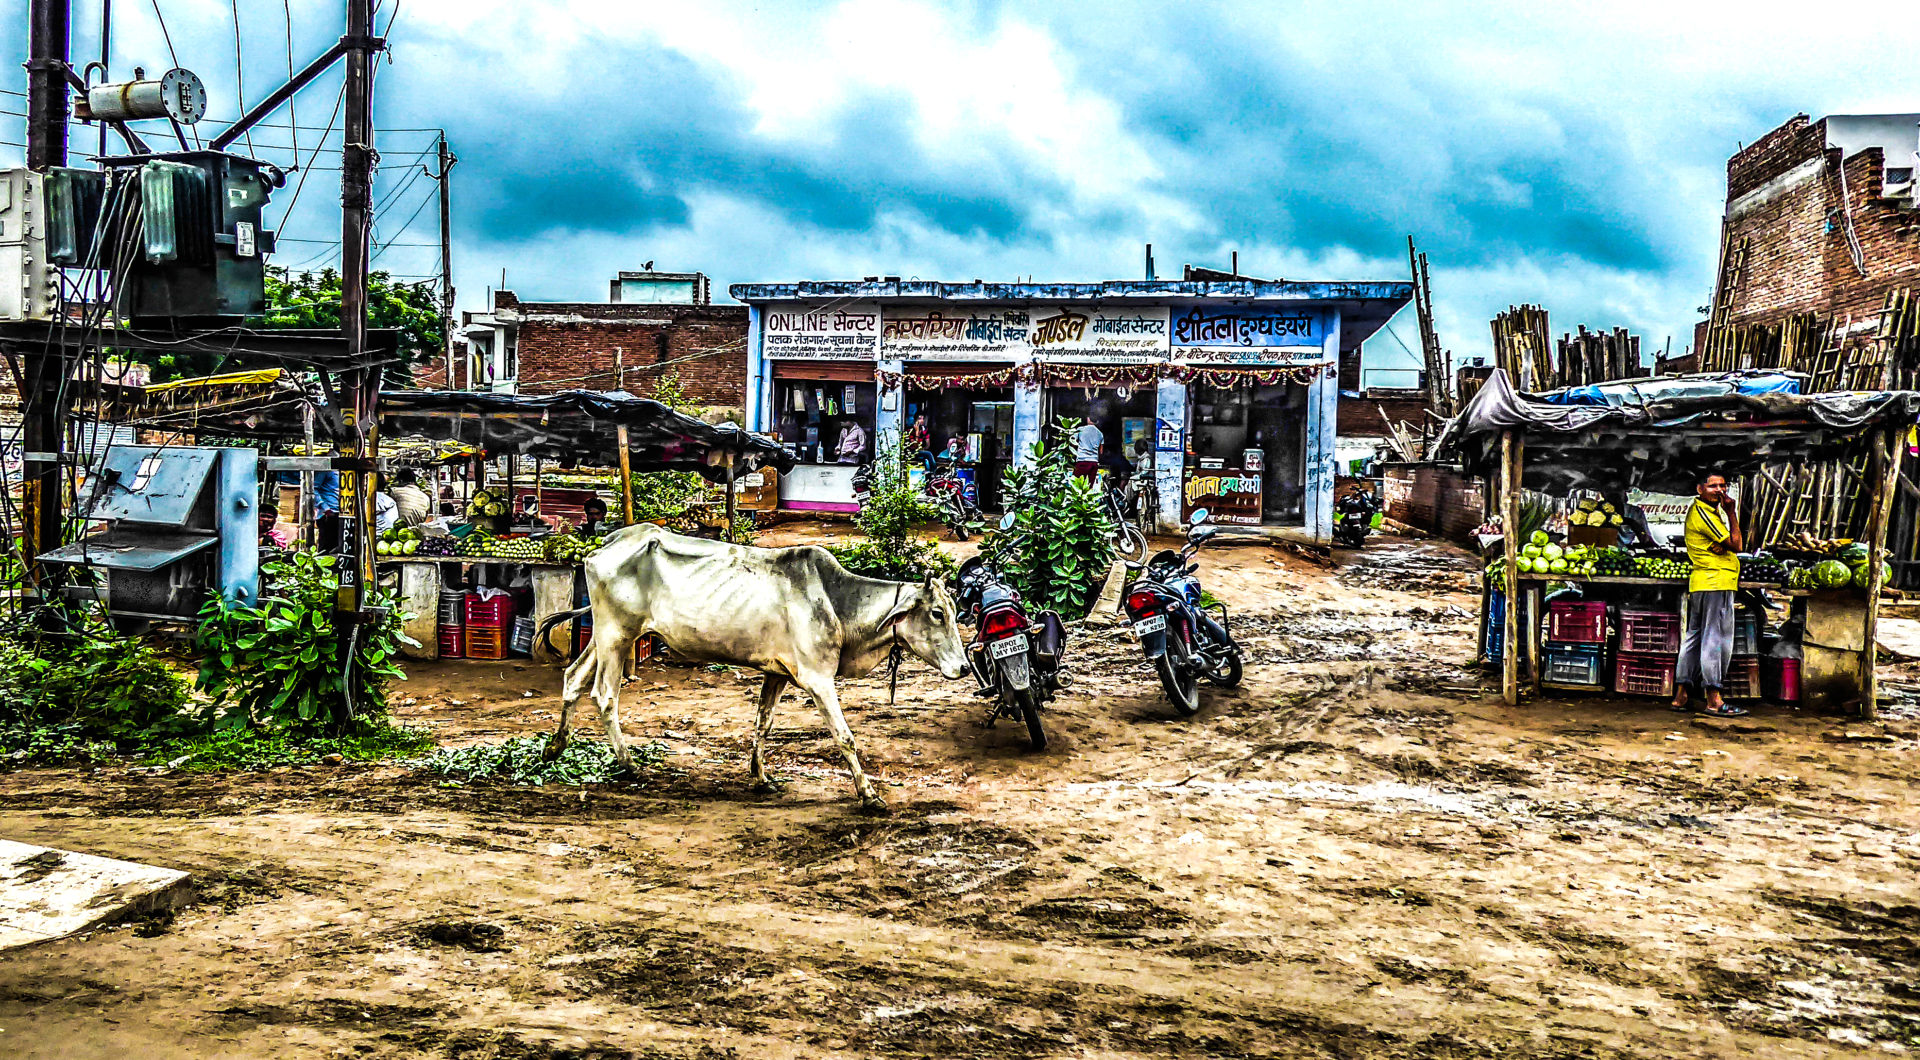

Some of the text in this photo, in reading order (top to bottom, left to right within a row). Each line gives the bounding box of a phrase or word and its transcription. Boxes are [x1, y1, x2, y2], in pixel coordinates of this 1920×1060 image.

[769, 310, 877, 331] ONLINE सेन्टर
[341, 570, 354, 585] 163
